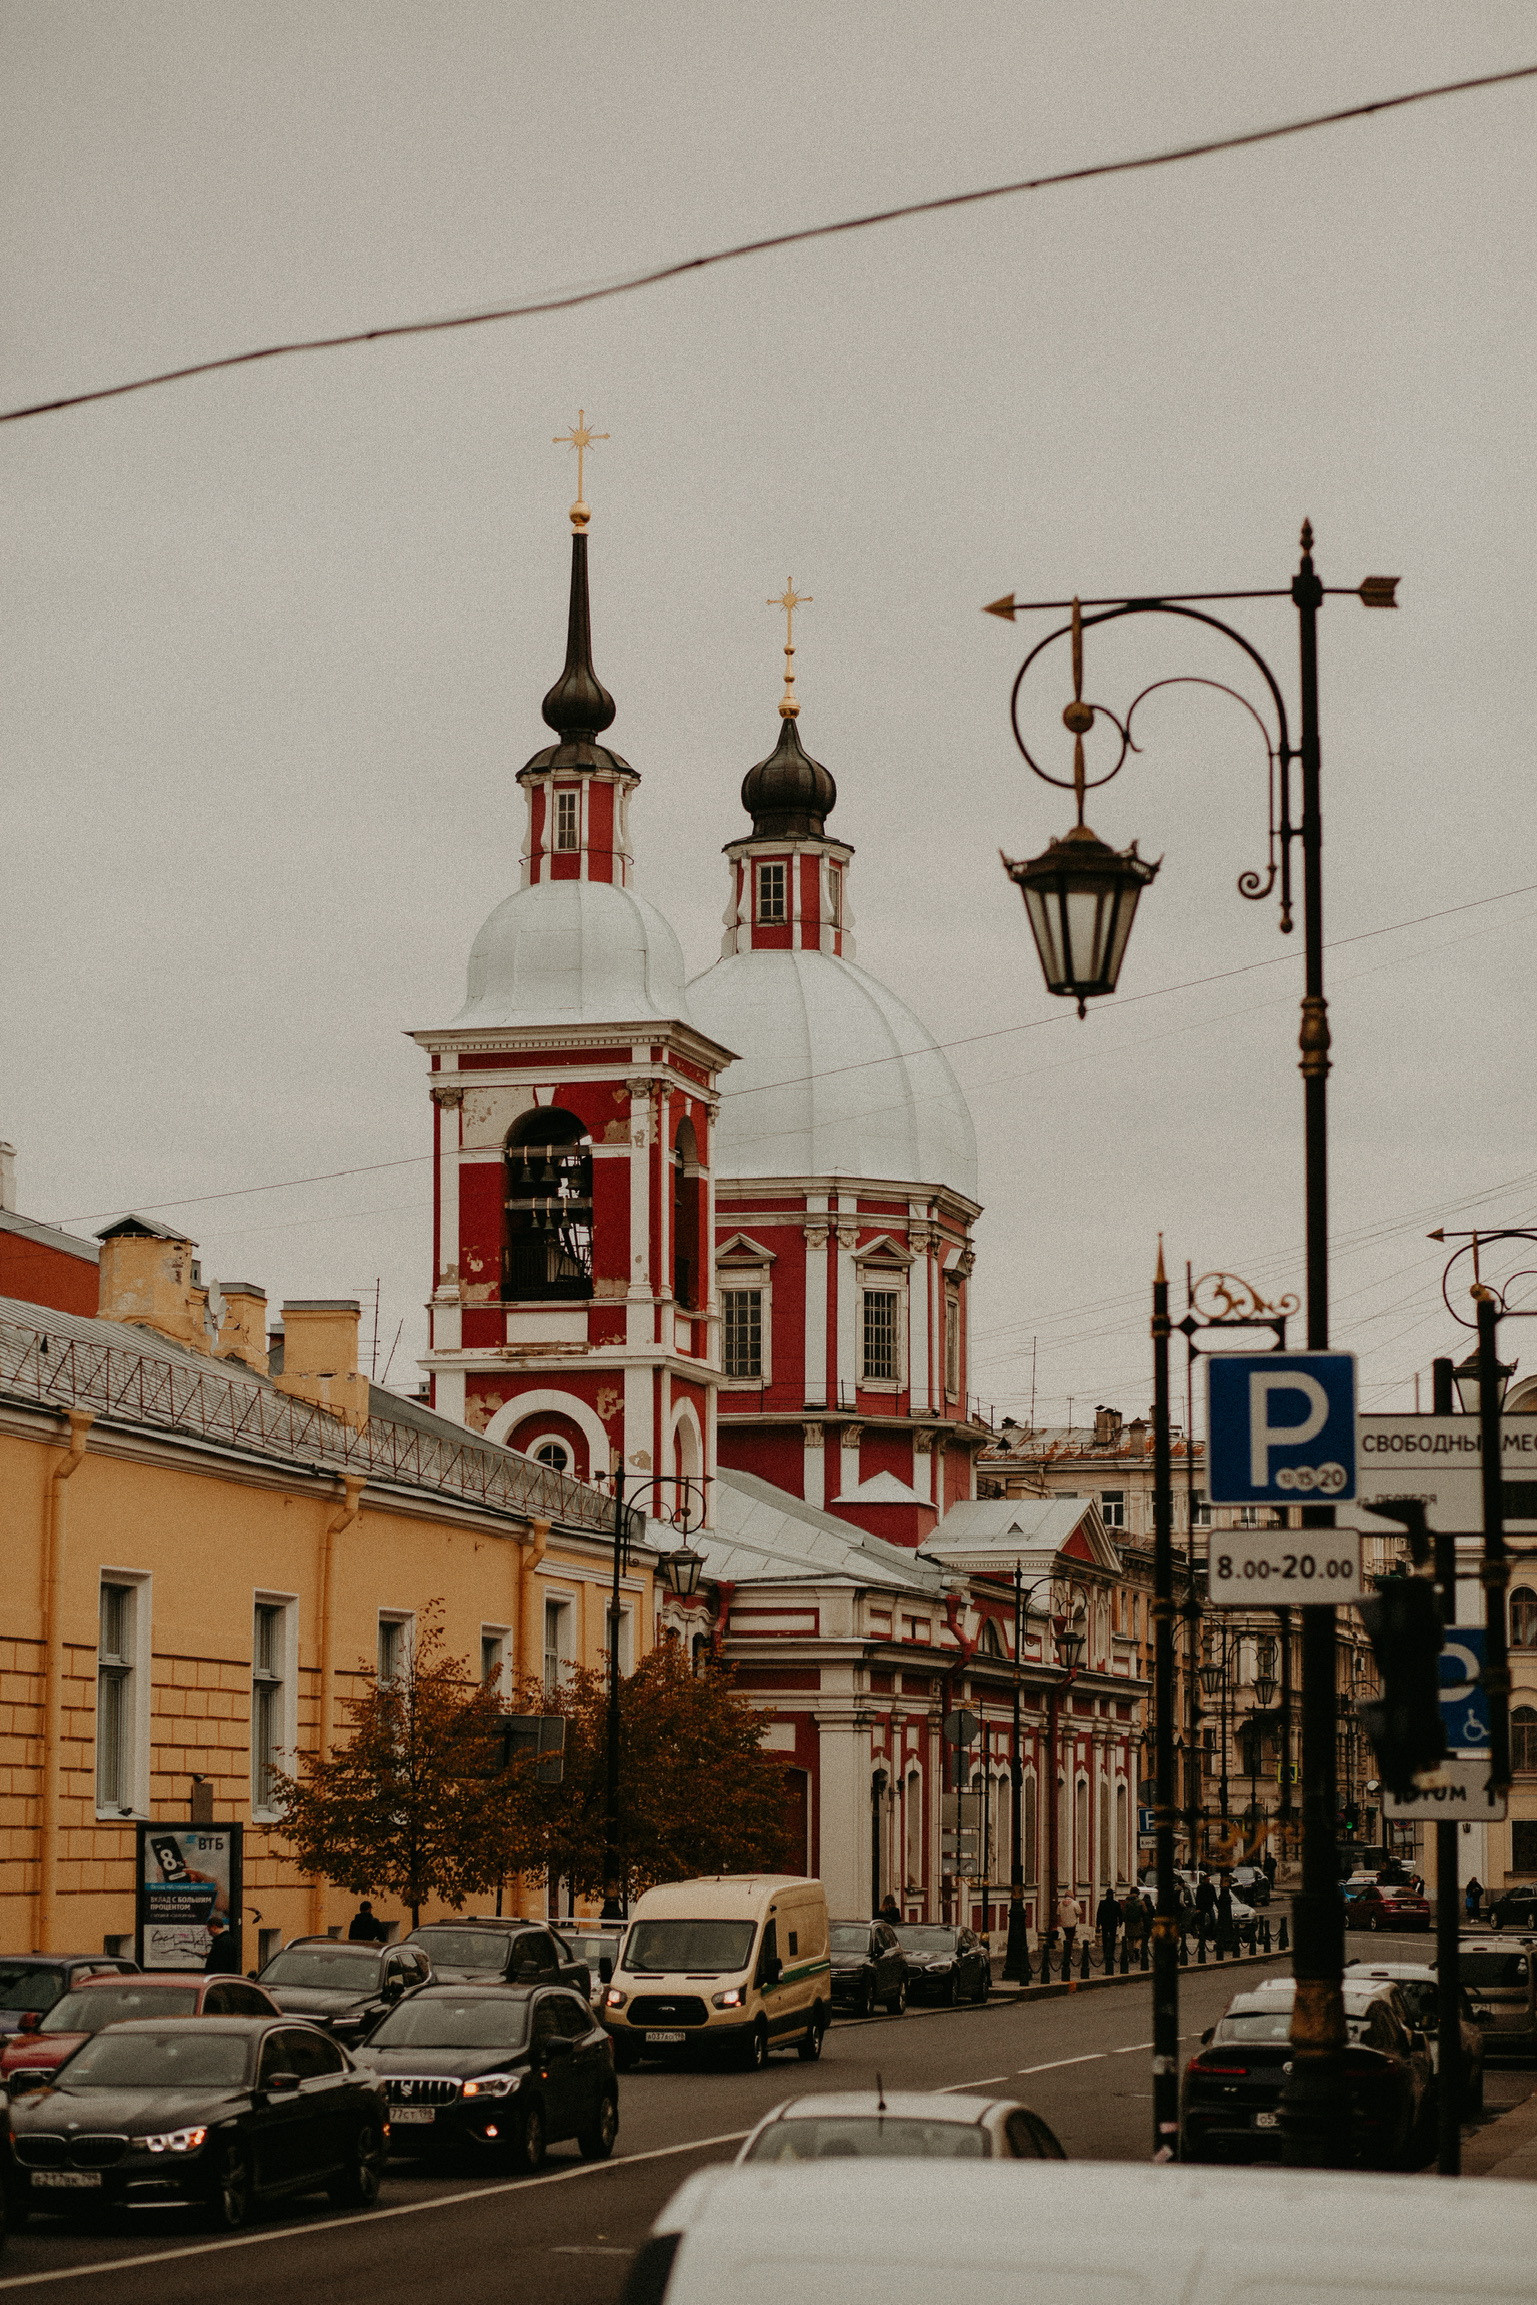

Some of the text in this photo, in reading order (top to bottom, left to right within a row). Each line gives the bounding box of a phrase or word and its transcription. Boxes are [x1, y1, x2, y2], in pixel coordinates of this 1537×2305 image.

[1250, 1371, 1329, 1487] P
[1362, 1434, 1483, 1454] СВОБОДНЫ
[1320, 1468, 1343, 1487] 20
[1217, 1554, 1353, 1579] 8.00-20.00
[198, 1838, 224, 1850] ВТБ
